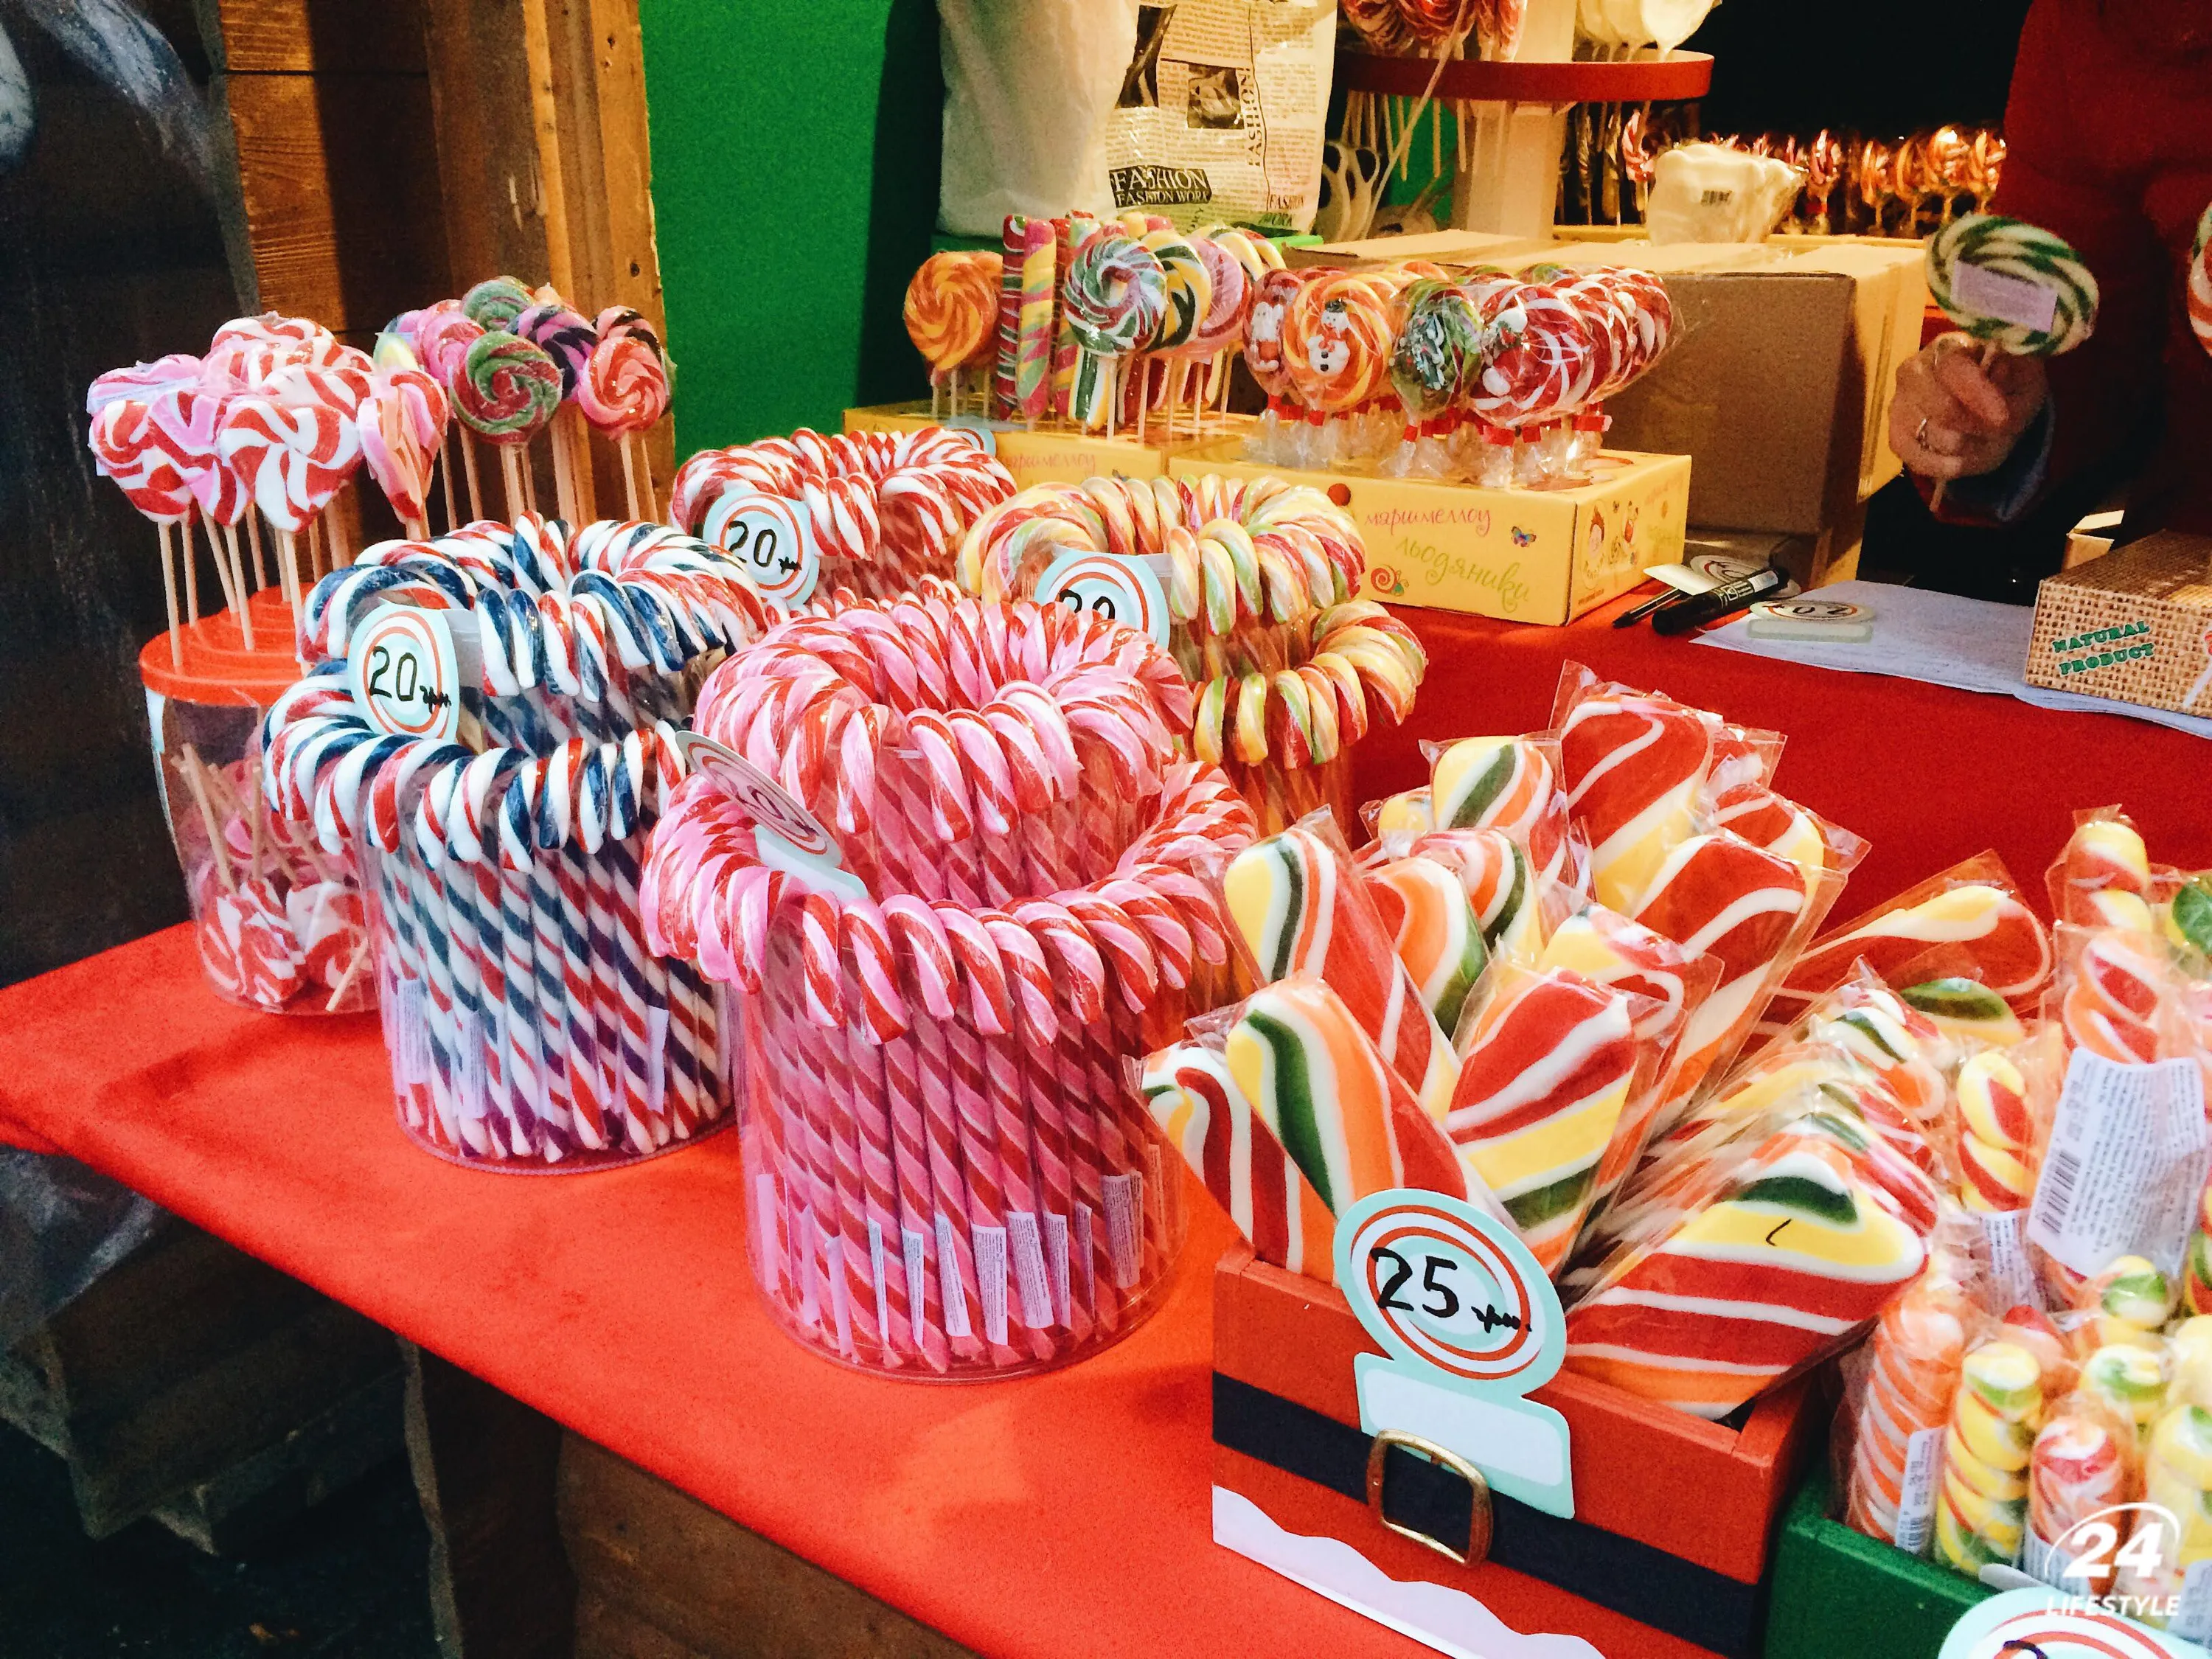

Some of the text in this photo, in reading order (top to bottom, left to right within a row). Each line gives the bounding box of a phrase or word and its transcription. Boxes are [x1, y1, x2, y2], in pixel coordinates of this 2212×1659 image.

[1111, 166, 1209, 193] FASHION
[727, 520, 777, 567] 20
[2053, 621, 2150, 653] NATURAL
[369, 646, 417, 701] 20
[2059, 643, 2154, 675] PRODUCT
[1370, 1247, 1460, 1318] 25
